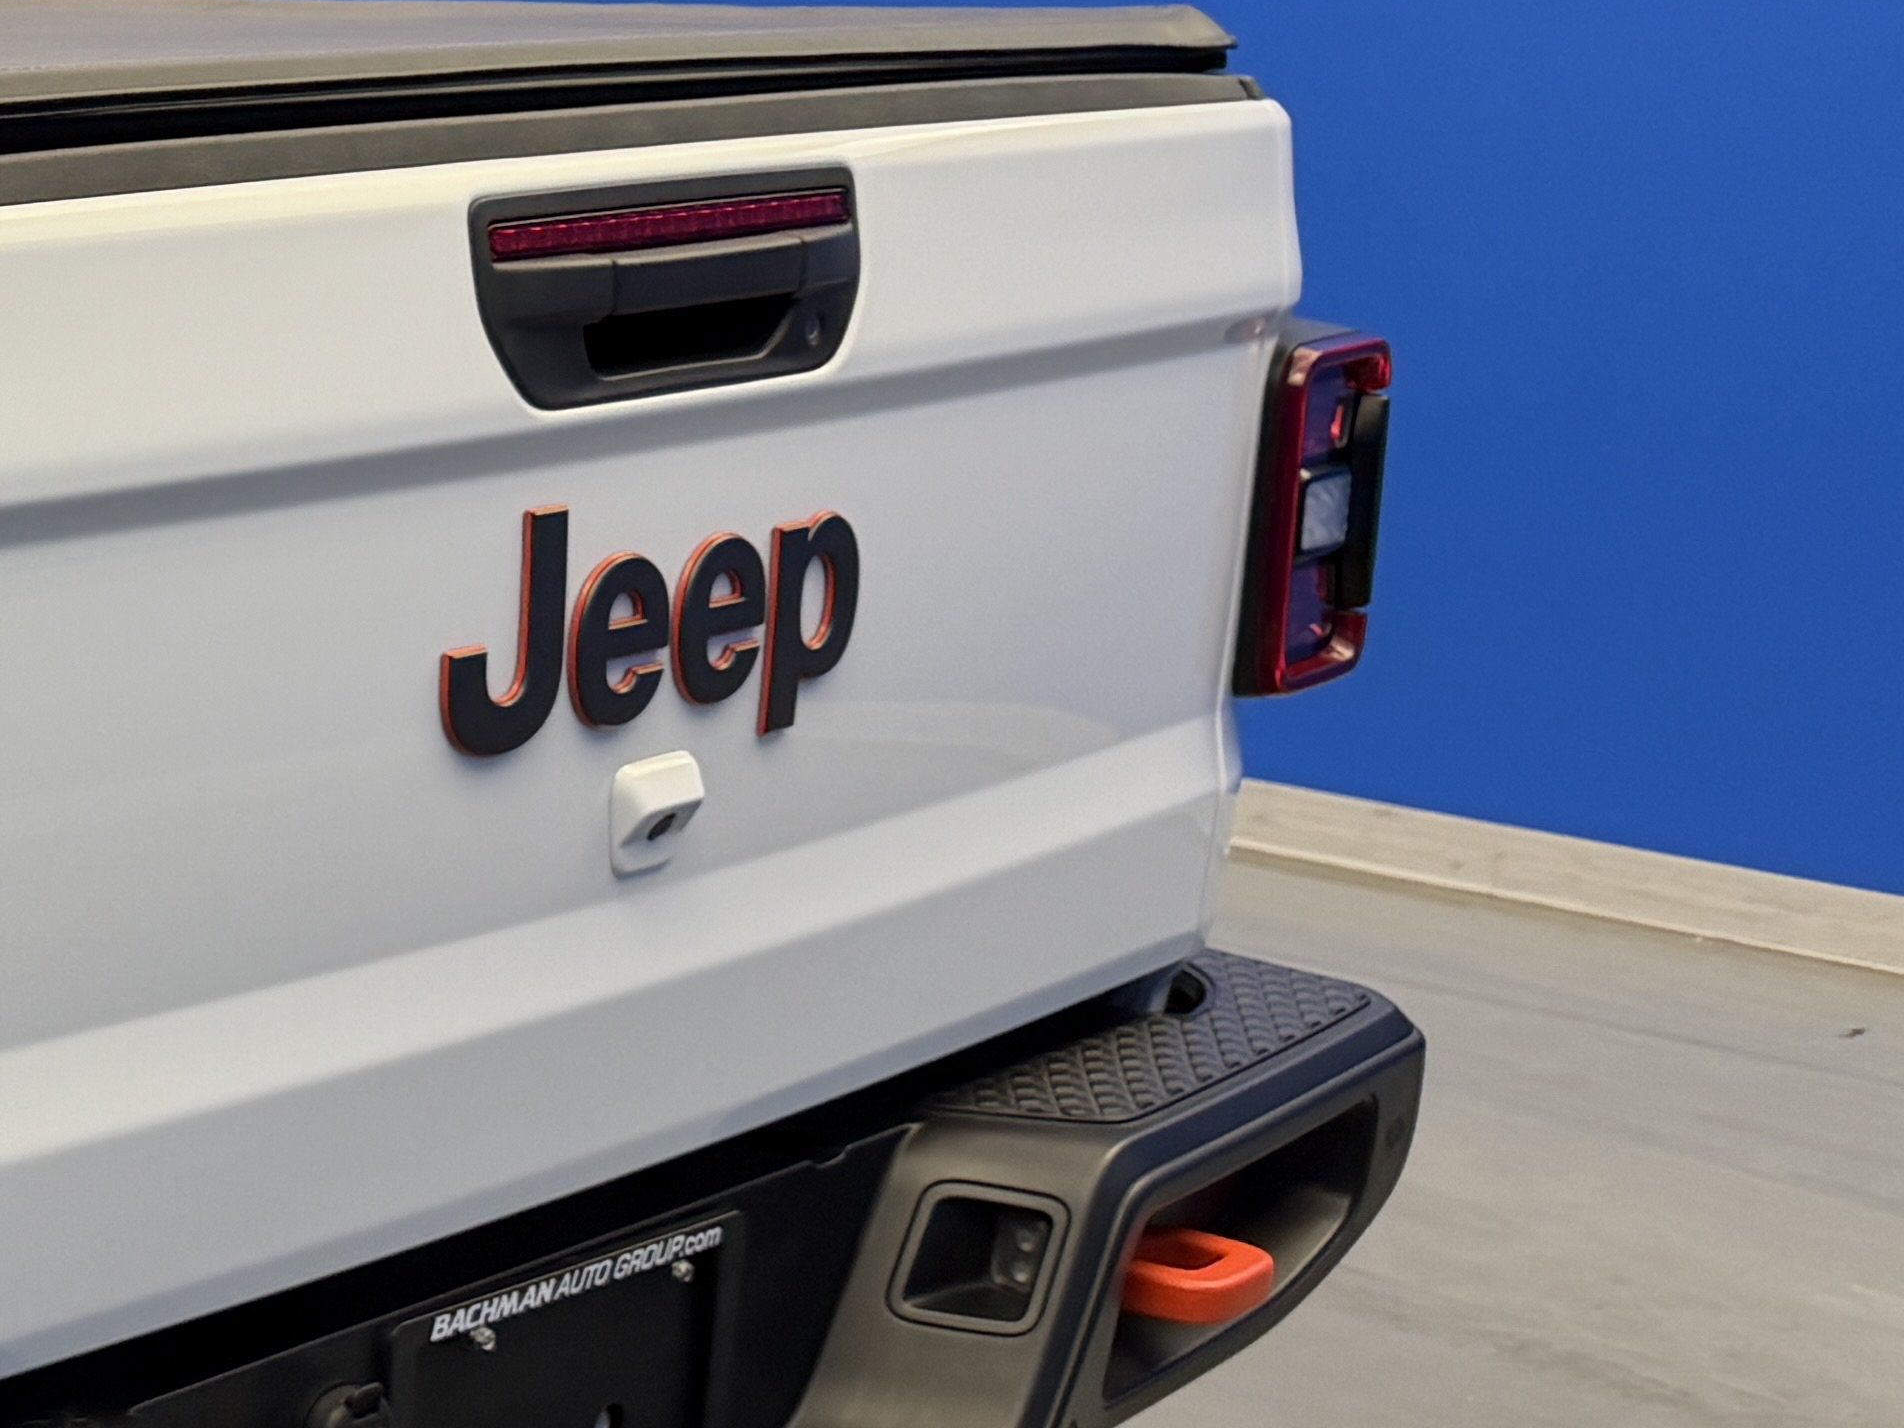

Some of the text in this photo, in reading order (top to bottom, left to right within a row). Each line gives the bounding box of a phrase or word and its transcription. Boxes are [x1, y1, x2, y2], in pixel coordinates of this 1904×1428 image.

[439, 503, 860, 756] Jeep
[430, 1226, 722, 1342] BACHMAN AUTO GROUP.com
